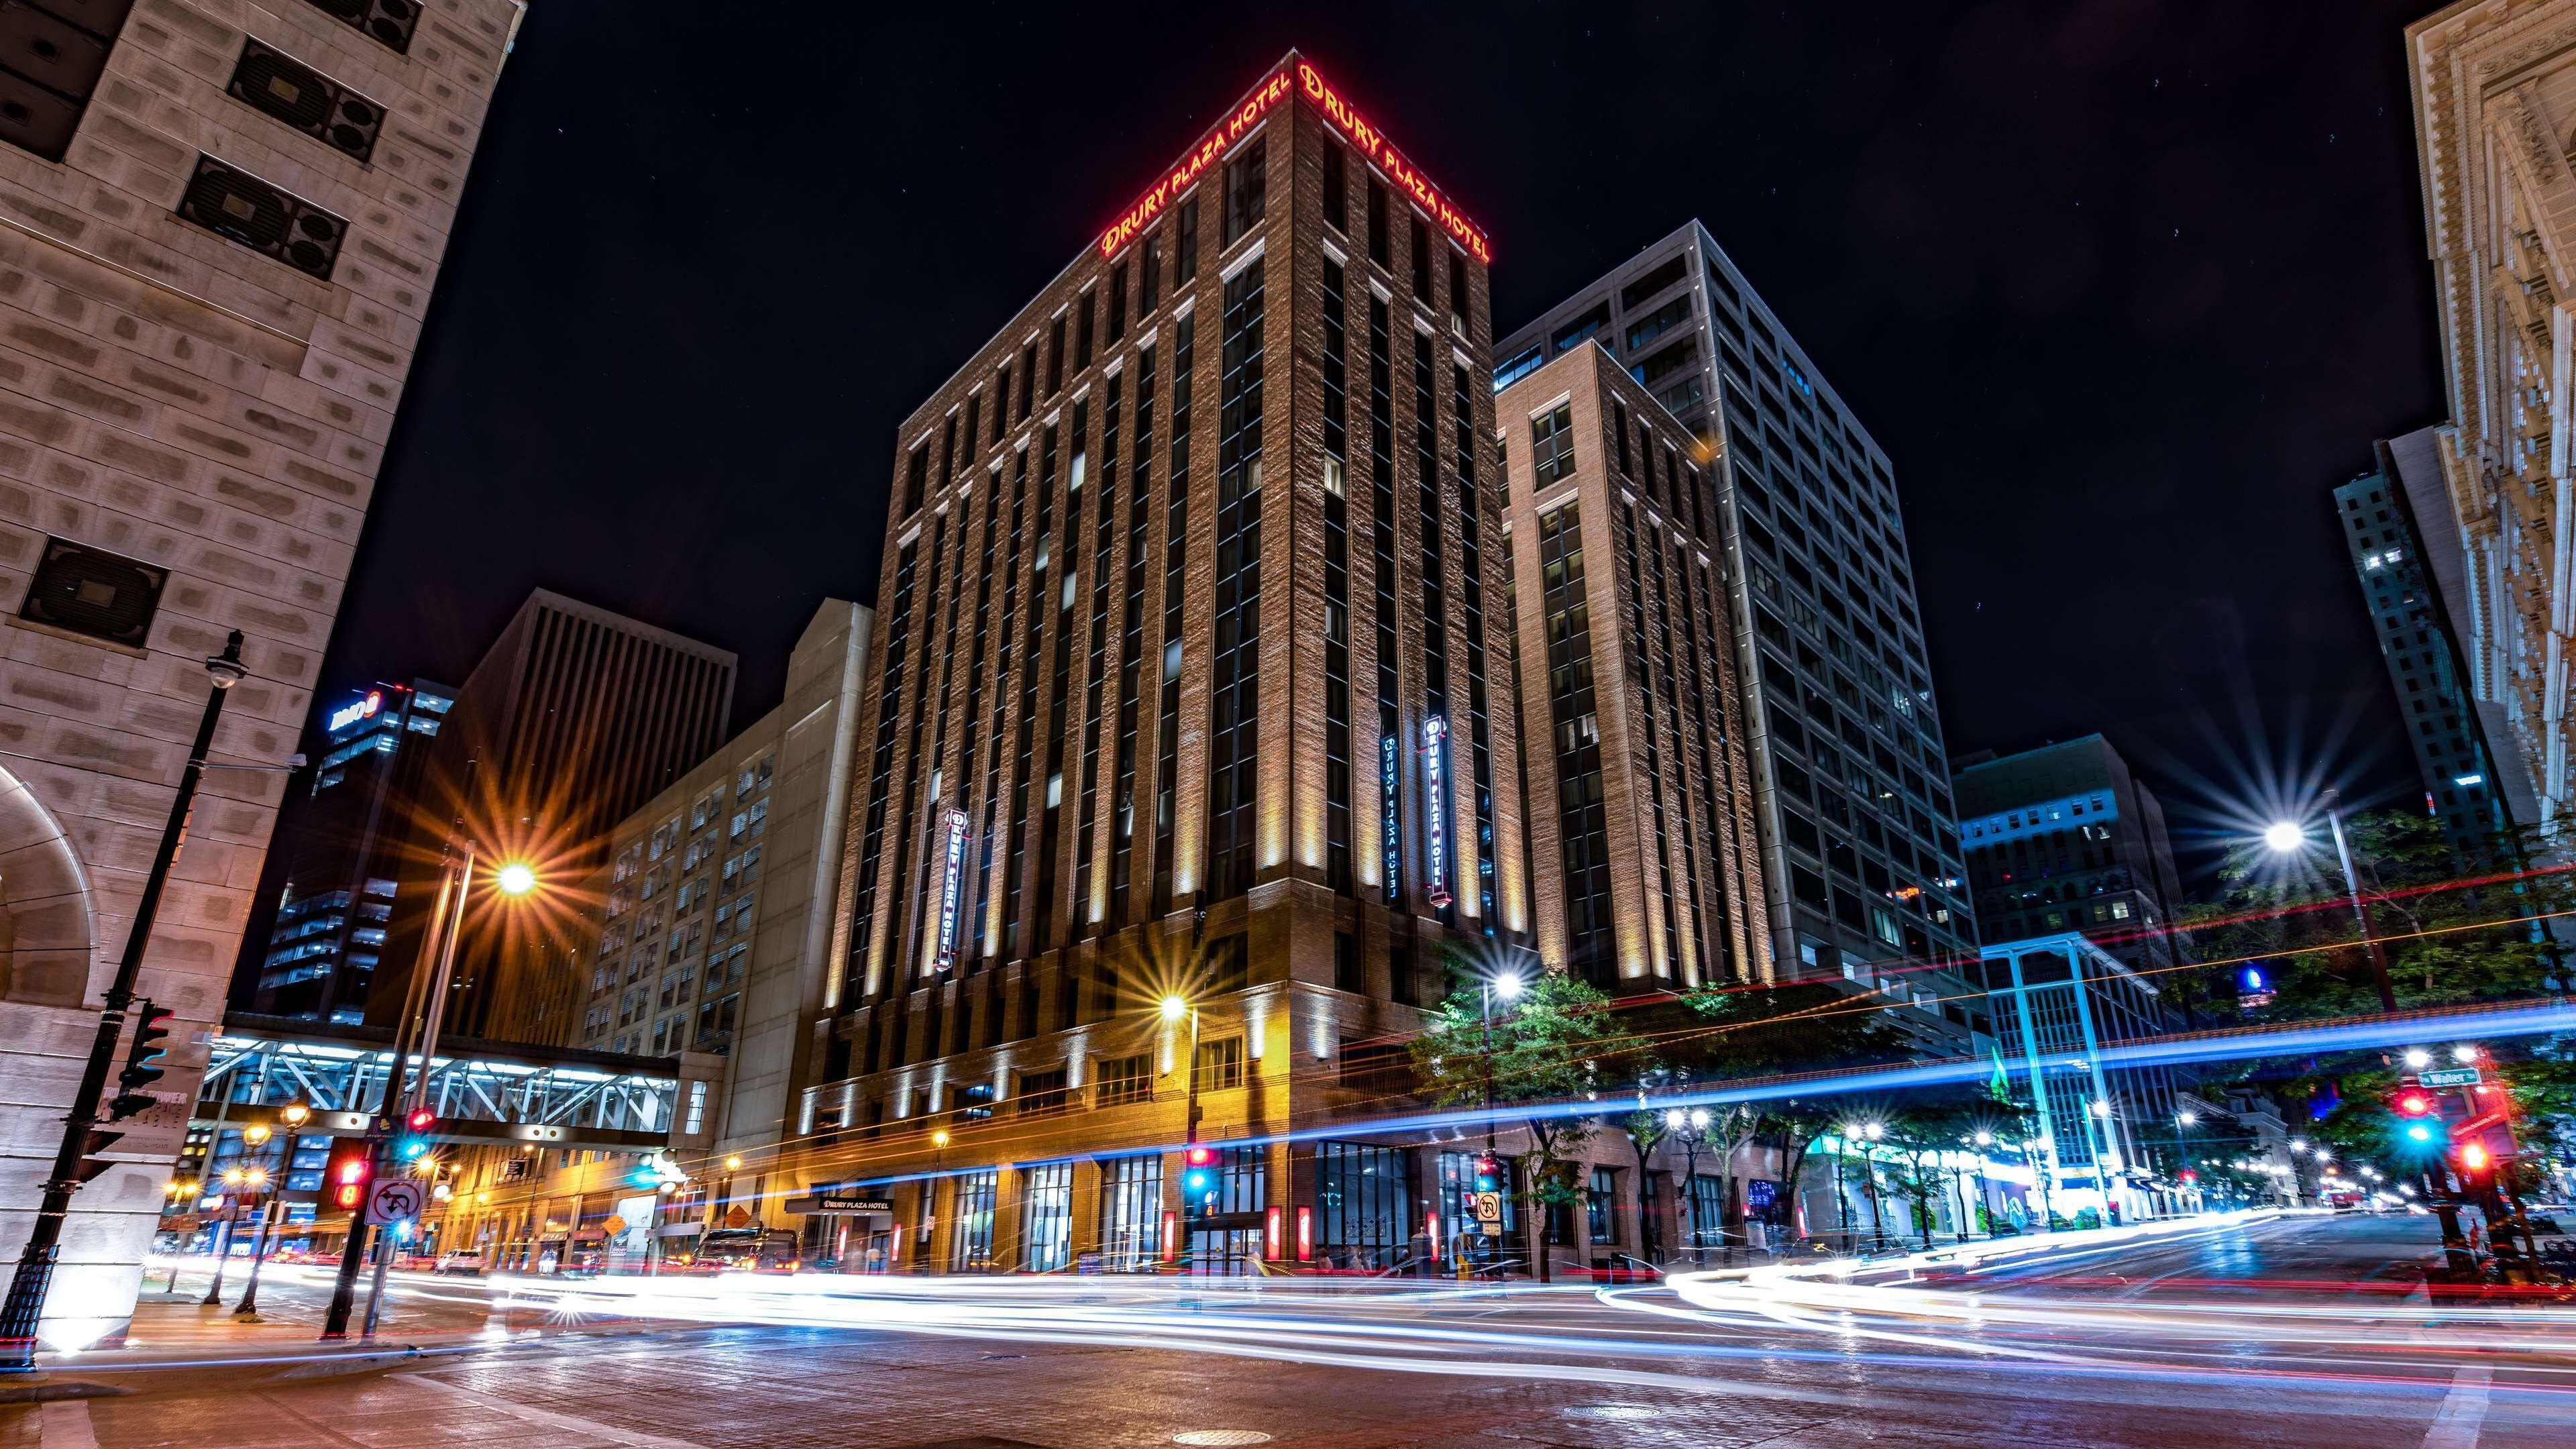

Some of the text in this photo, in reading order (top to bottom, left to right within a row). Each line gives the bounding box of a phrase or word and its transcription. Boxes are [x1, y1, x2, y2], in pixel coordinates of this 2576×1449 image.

[1102, 72, 1290, 257] DRURY PLAZA HOTEL
[1299, 64, 1490, 263] DRURY PLAZA HOTEL
[942, 814, 964, 953] DRURY PLAZA HOTEL
[1427, 721, 1442, 886] DRURY PLAZA HOTEL
[2429, 1073, 2465, 1084] Water
